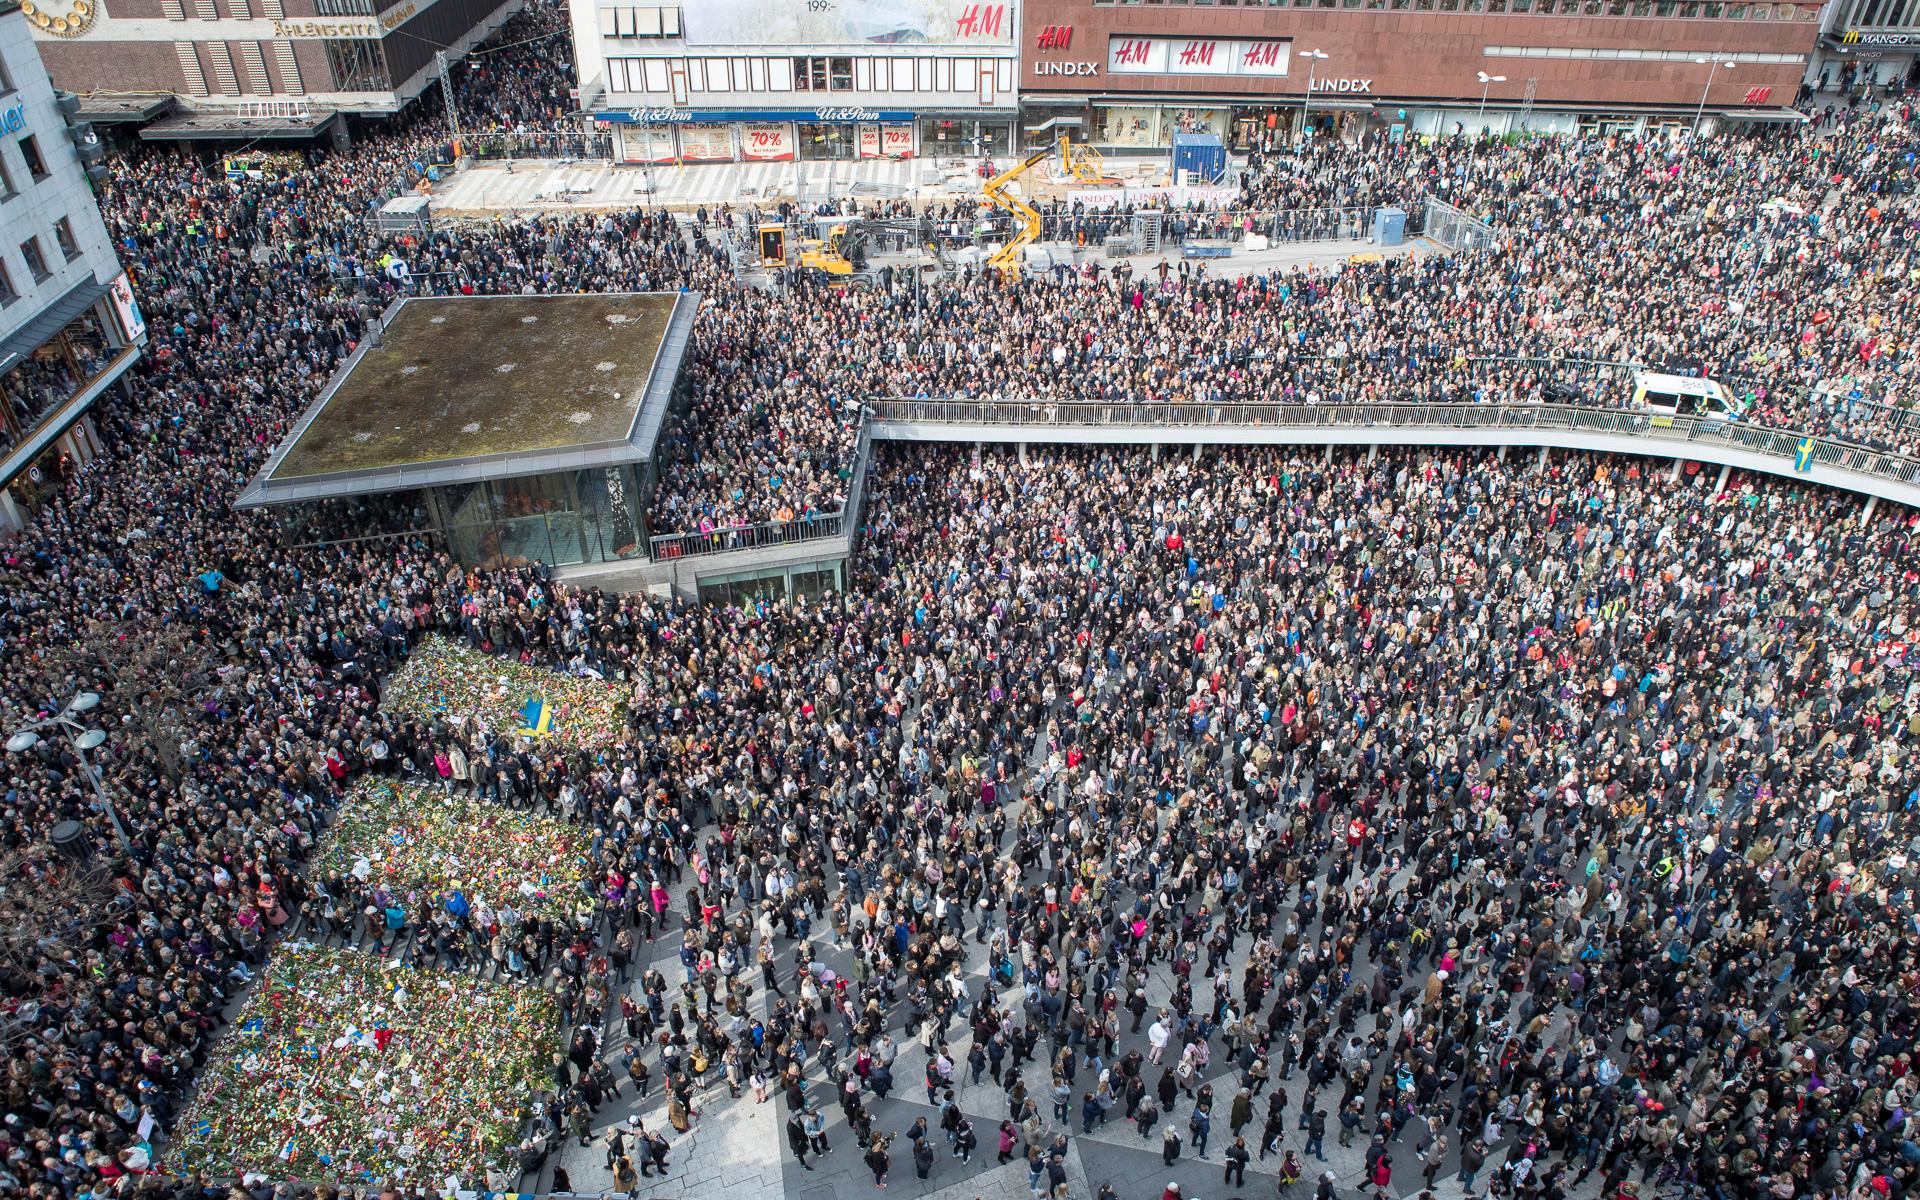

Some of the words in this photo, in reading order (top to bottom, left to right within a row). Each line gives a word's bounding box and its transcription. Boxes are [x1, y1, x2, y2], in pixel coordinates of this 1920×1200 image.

[806, 1, 836, 12] 199:-
[956, 4, 1004, 38] H&M
[339, 22, 372, 37] CITY
[1036, 24, 1073, 50] H&M
[1861, 34, 1909, 44] MANGO
[1115, 40, 1152, 65] H&M
[1179, 41, 1217, 66] H&M
[1243, 42, 1281, 67] H&M
[1034, 61, 1098, 76] LINDEX
[1310, 78, 1373, 92] LINDEX
[815, 106, 880, 120] Ur&Penn
[750, 132, 782, 147] 70%
[885, 131, 910, 144] 70%
[1133, 191, 1175, 200] LINDX
